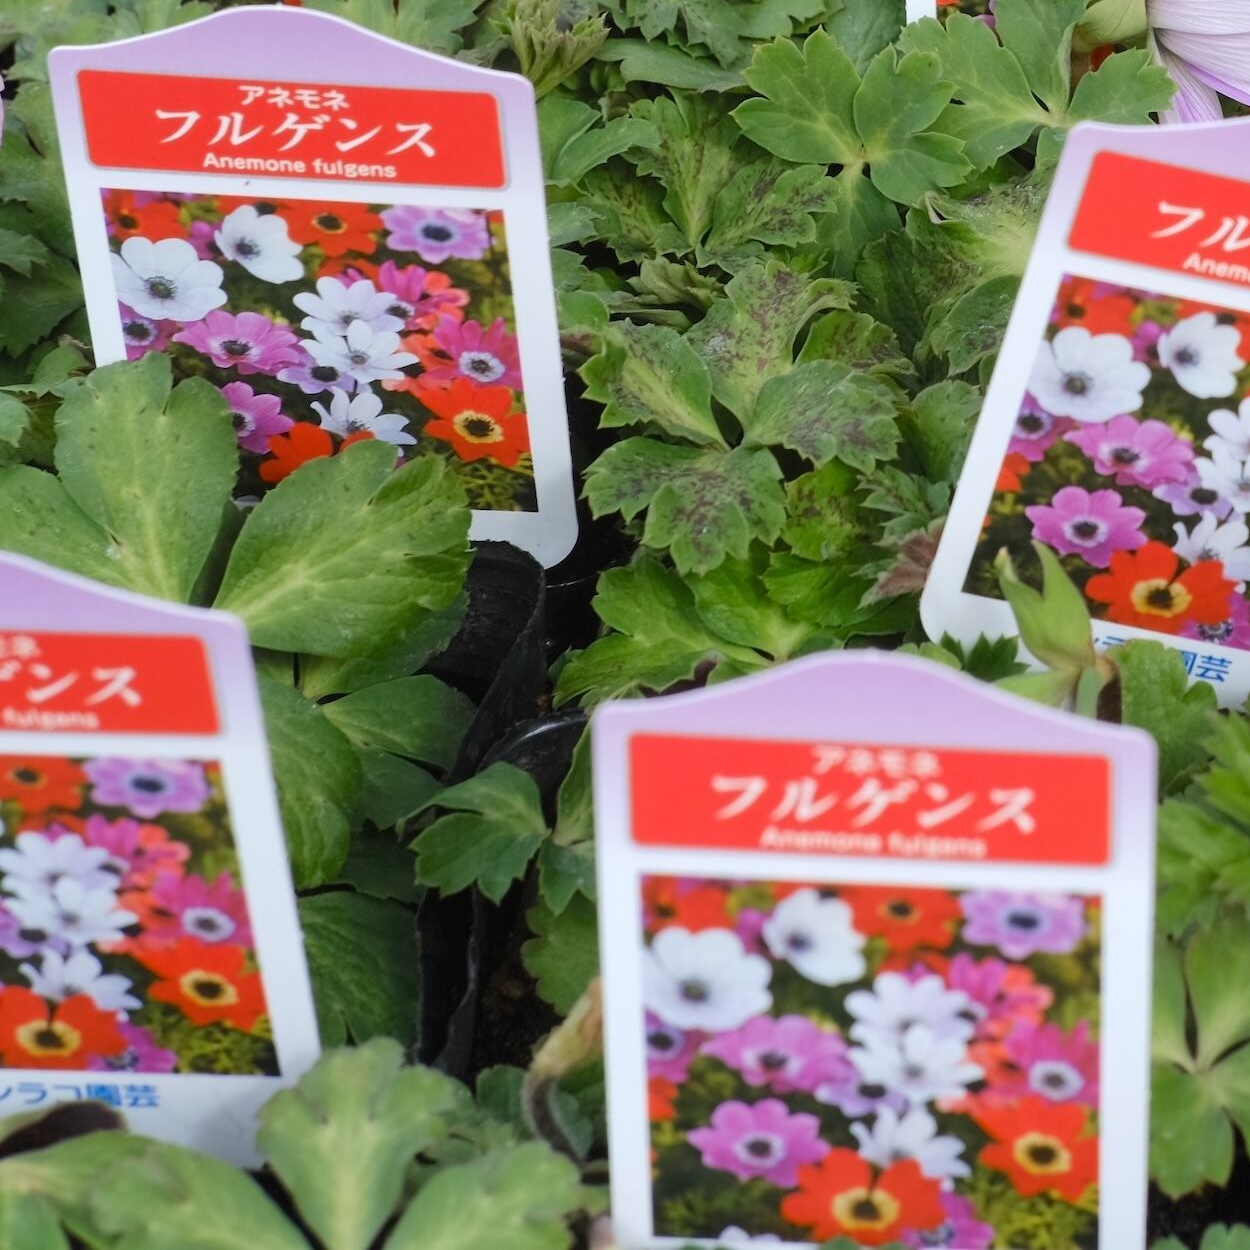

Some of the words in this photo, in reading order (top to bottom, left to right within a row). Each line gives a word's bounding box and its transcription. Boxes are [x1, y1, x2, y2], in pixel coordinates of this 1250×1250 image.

[239, 85, 349, 111] アネモネ
[155, 110, 435, 157] フルゲンス
[203, 153, 306, 173] Anemone
[312, 158, 397, 178] fulgens
[814, 749, 939, 778] アネモネ
[712, 776, 1035, 834] フルゲンス
